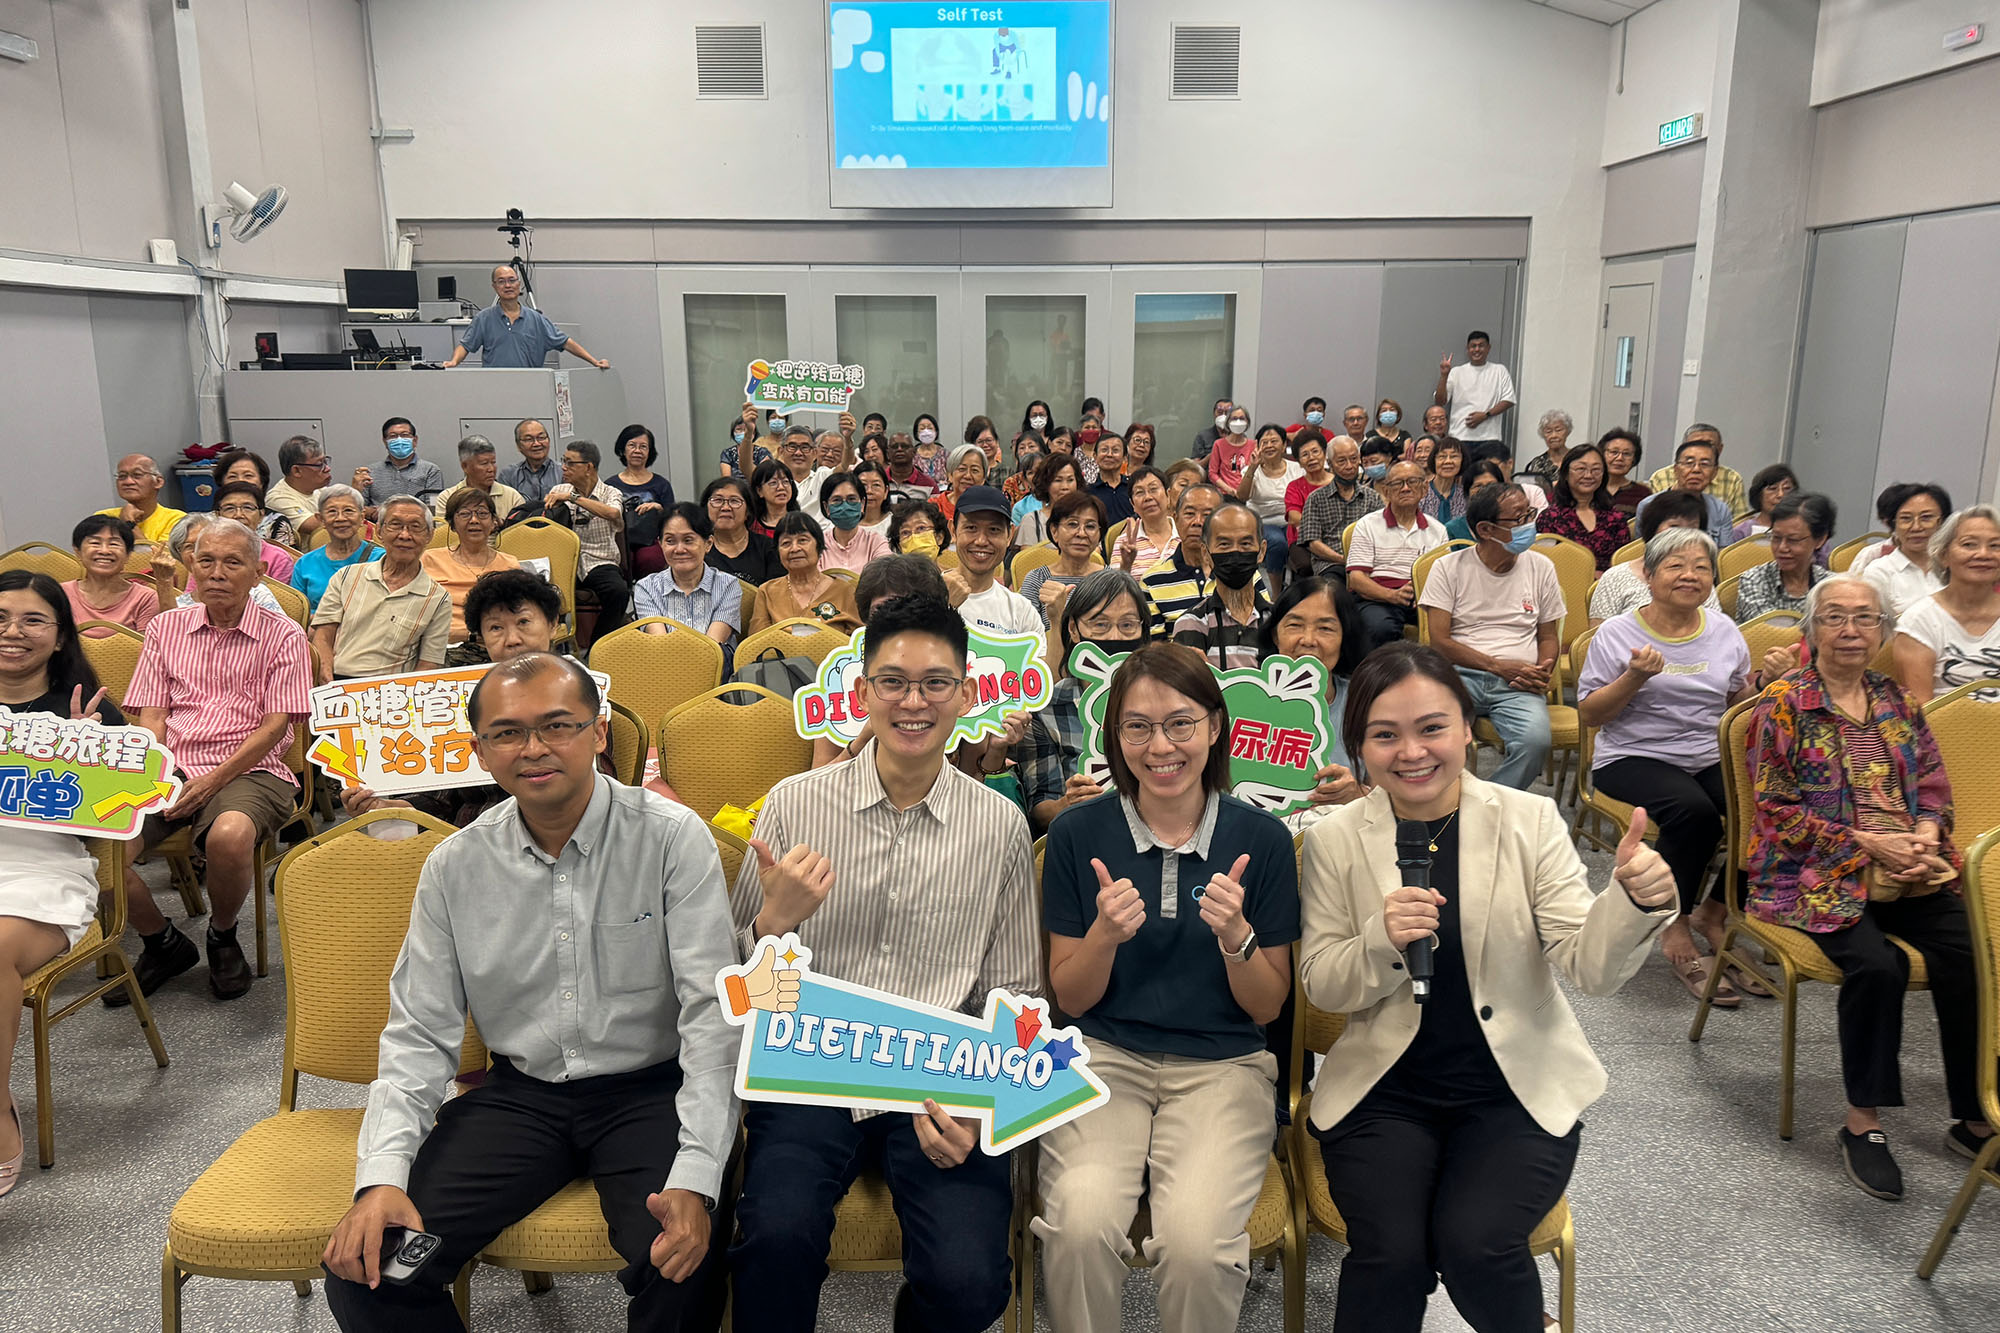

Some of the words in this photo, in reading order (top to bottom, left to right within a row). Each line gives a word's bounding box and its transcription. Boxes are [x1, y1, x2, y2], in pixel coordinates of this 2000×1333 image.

[937, 7, 967, 21] Self
[970, 7, 1003, 21] Test
[983, 125, 998, 133] long
[1661, 119, 1687, 142] KELUAR
[776, 362, 863, 385] 把逆转血糖
[762, 382, 846, 404] 变成有可能
[0, 712, 150, 773] 糖旅程
[764, 1010, 1054, 1091] DIETITIANGO
